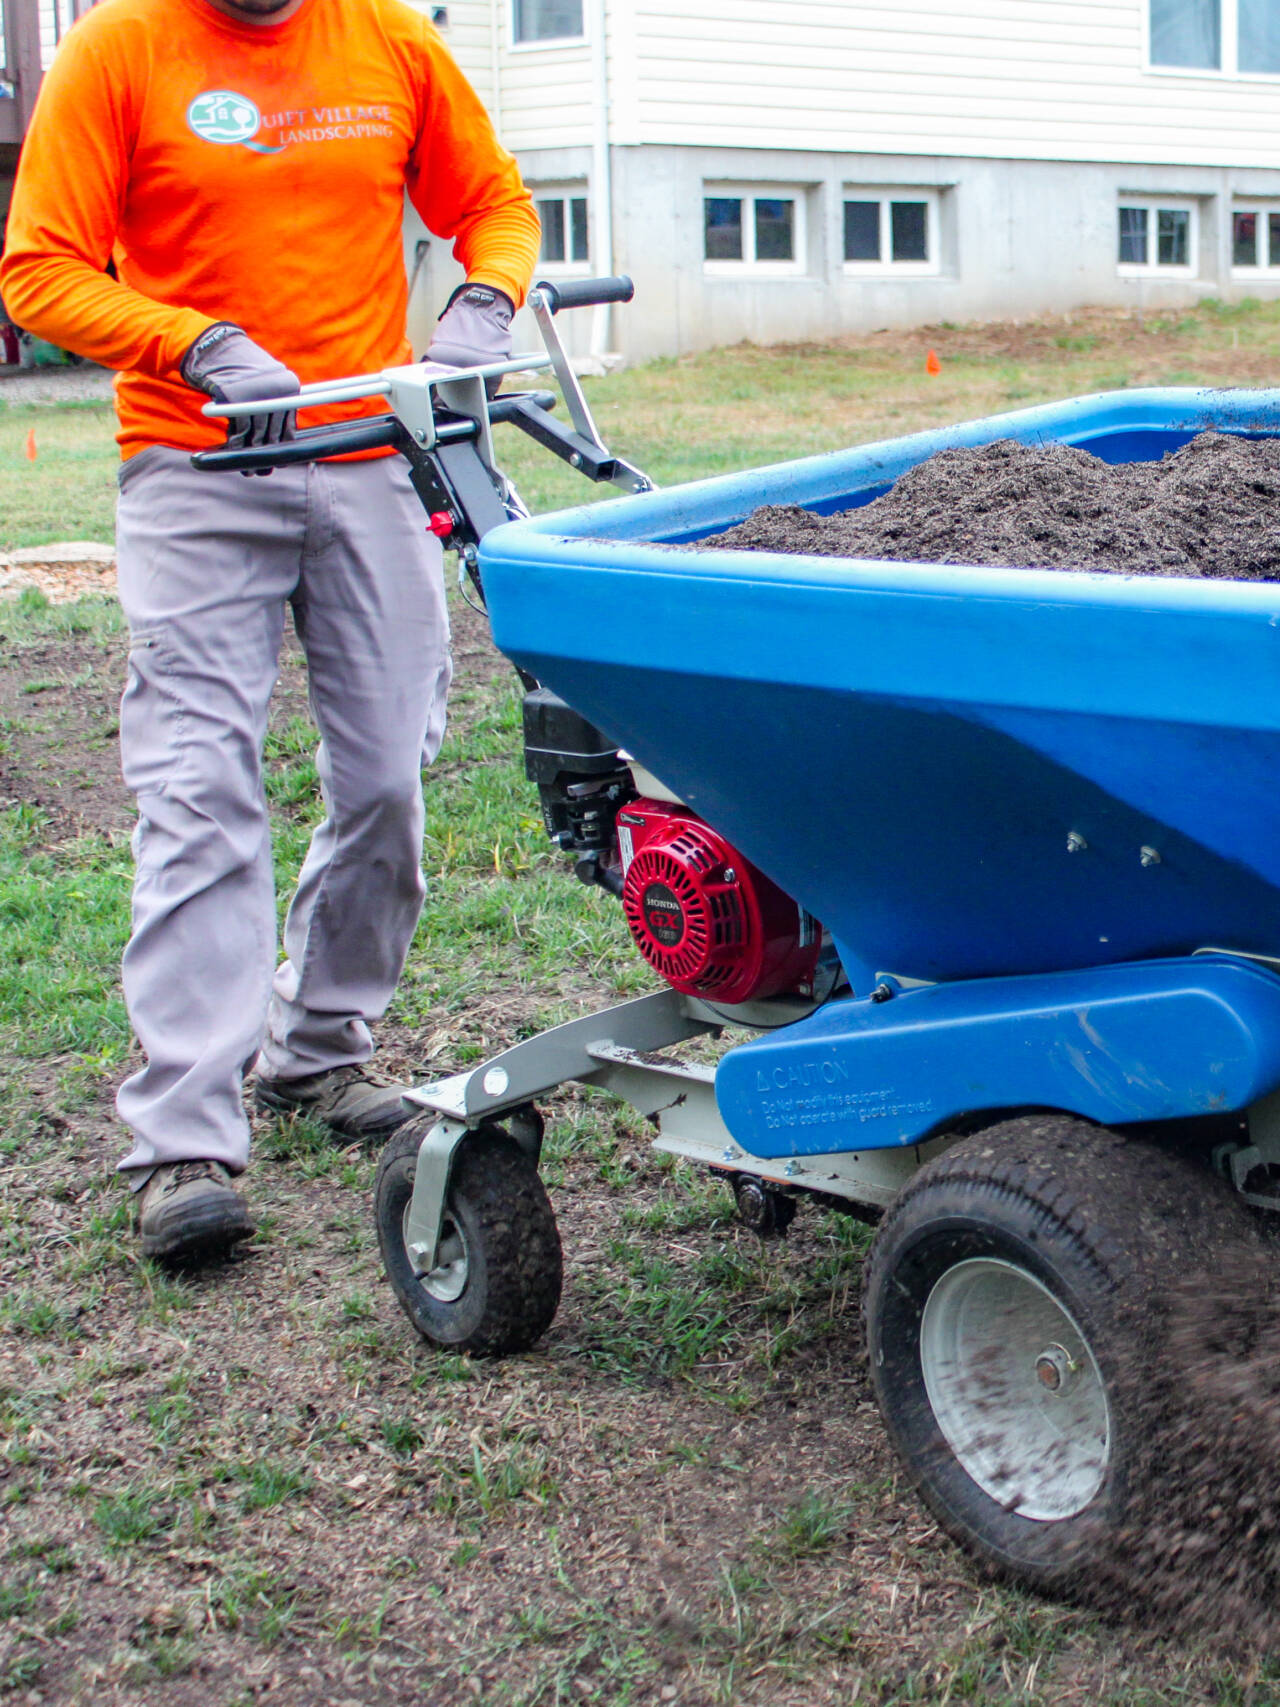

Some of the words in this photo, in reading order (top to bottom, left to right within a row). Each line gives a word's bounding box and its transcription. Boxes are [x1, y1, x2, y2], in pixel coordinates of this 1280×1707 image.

[312, 105, 393, 124] VILLAGE
[279, 124, 393, 145] LANDSCAPING
[647, 898, 680, 910] HONDA
[650, 911, 680, 929] GX
[772, 1060, 849, 1089] CAUTION
